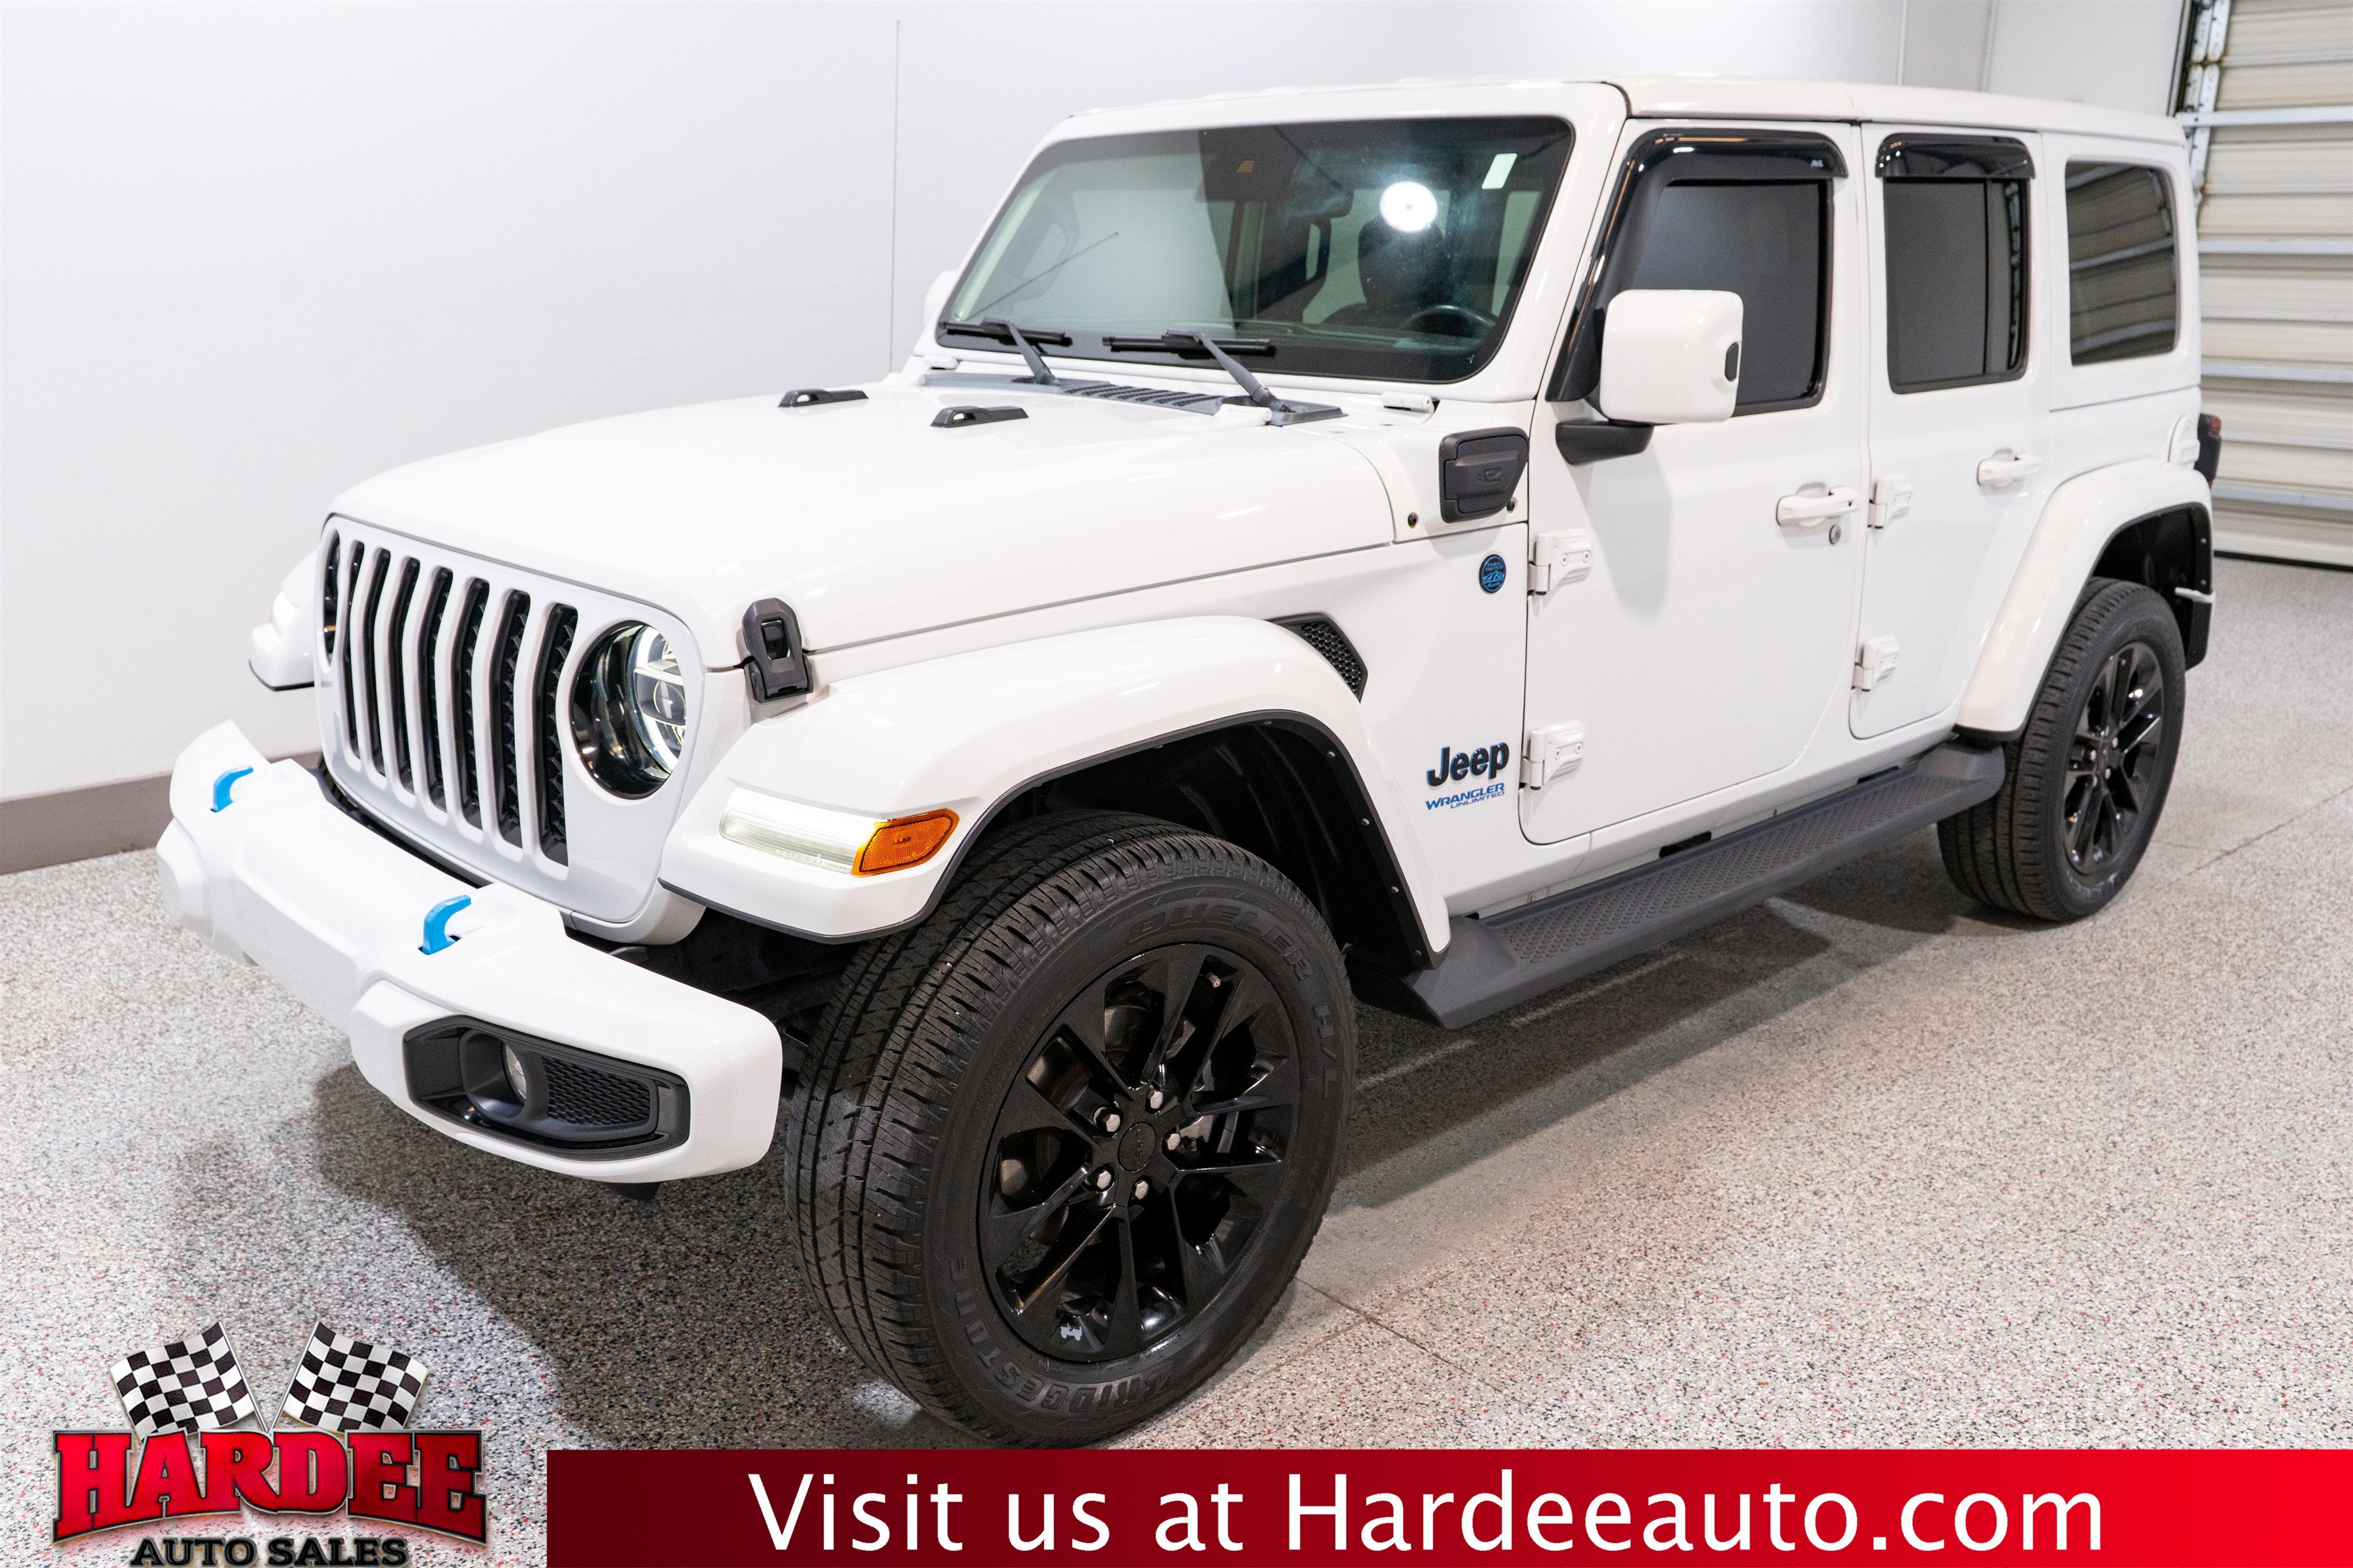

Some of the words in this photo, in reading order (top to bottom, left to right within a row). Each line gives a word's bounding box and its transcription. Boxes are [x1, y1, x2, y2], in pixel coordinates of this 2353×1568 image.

[1426, 742, 1510, 787] Jeep
[1425, 782, 1505, 810] WRANGLER
[1451, 790, 1505, 809] UNLIMITED
[949, 1256, 1174, 1413] BRIDGESTONE
